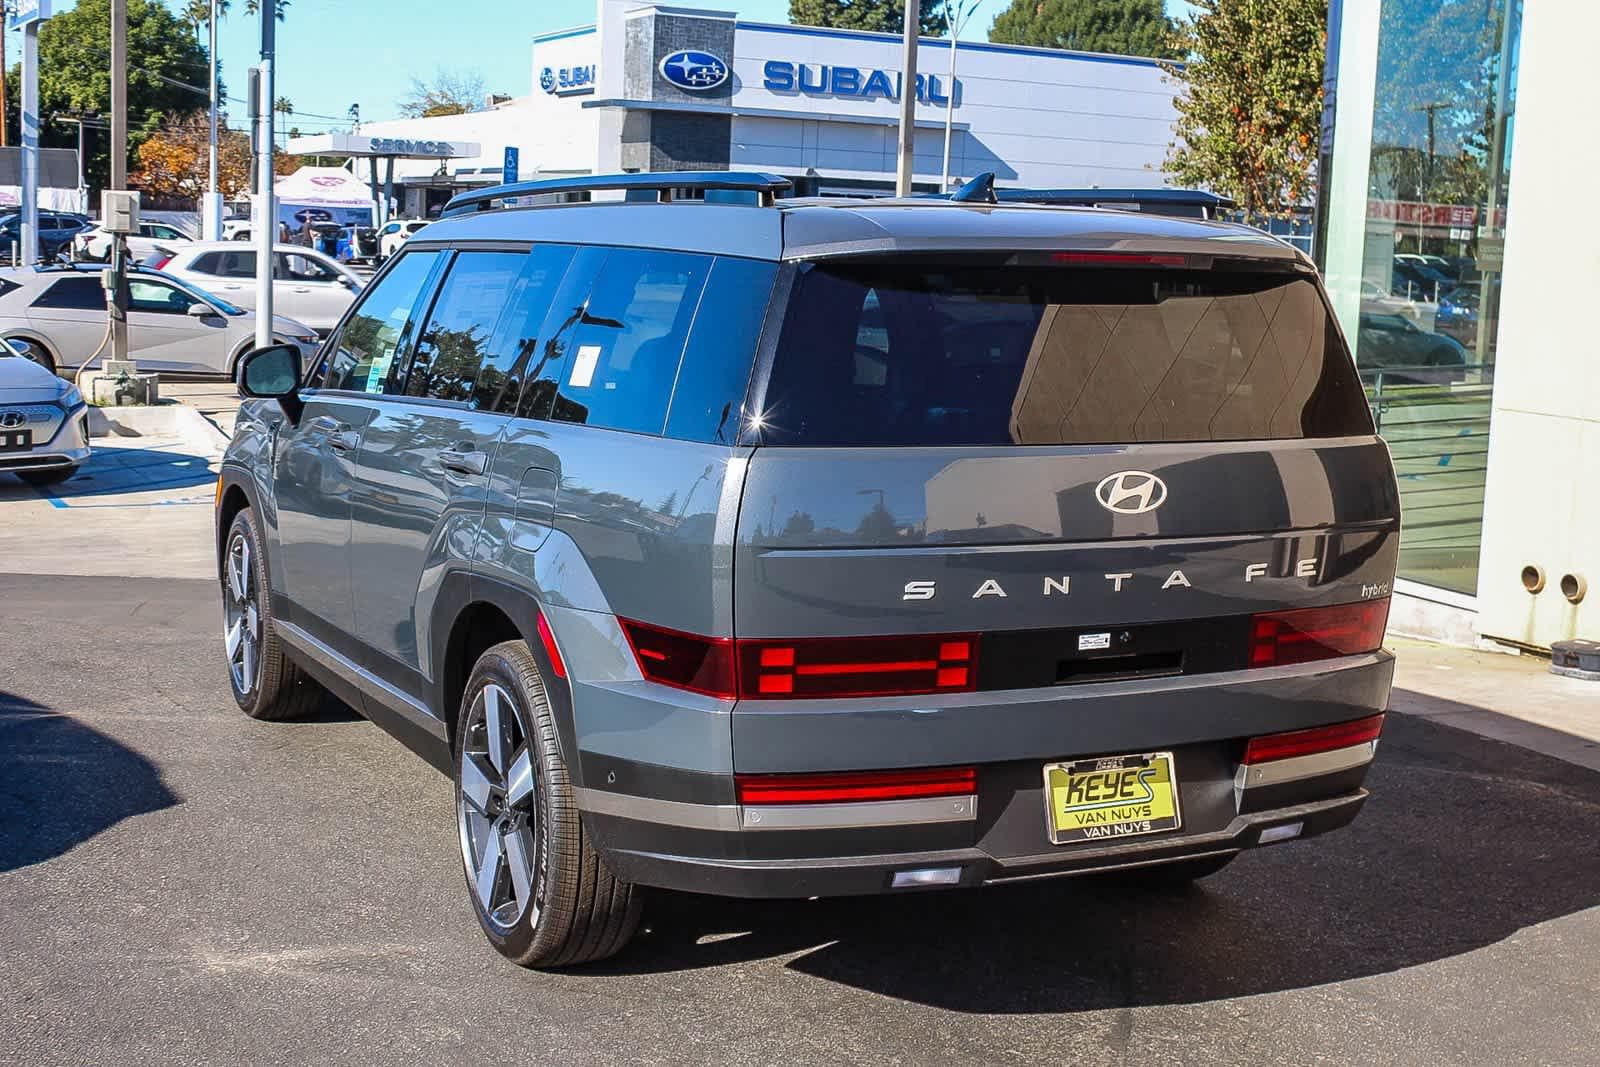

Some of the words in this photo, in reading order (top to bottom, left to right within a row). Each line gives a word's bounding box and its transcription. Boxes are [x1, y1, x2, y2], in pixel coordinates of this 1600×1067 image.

[370, 138, 452, 155] SERVICE
[903, 570, 1192, 600] SANTA
[1245, 558, 1318, 583] FE
[1361, 583, 1389, 599] hybrid
[1066, 769, 1156, 804] KEYES
[1075, 811, 1106, 825] VAN
[1111, 805, 1151, 820] NUYS
[1083, 826, 1111, 838] VAN
[1115, 821, 1151, 835] NUYS
